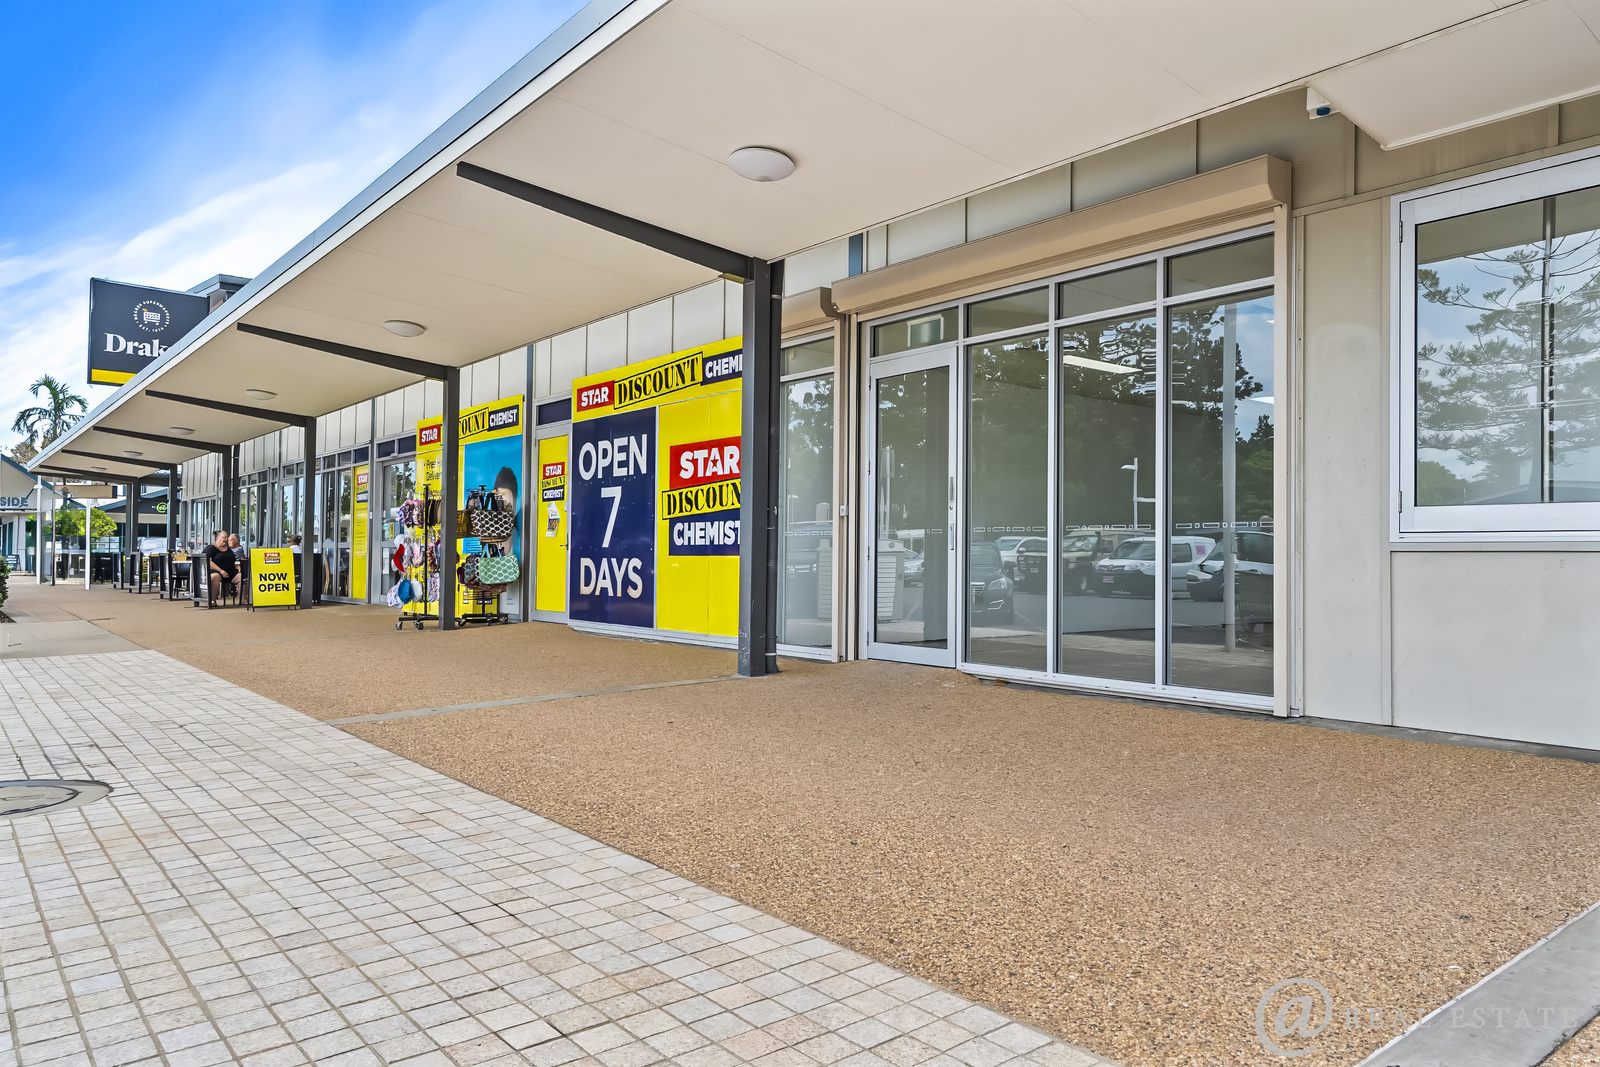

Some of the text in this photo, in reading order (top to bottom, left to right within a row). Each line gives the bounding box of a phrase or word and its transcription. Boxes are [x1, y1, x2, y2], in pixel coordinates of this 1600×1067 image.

[580, 386, 609, 408] STAR
[618, 356, 698, 405] DISCOUNT
[421, 408, 518, 443] STAR OUNT CHEMIST
[544, 464, 563, 477] STAR
[578, 433, 648, 481] OPEN
[679, 445, 741, 480] STAR
[543, 488, 564, 499] CHEMIST
[600, 485, 622, 548] 7
[258, 582, 290, 593] OPEN
[259, 572, 288, 582] NOW
[579, 557, 643, 599] DAYS
